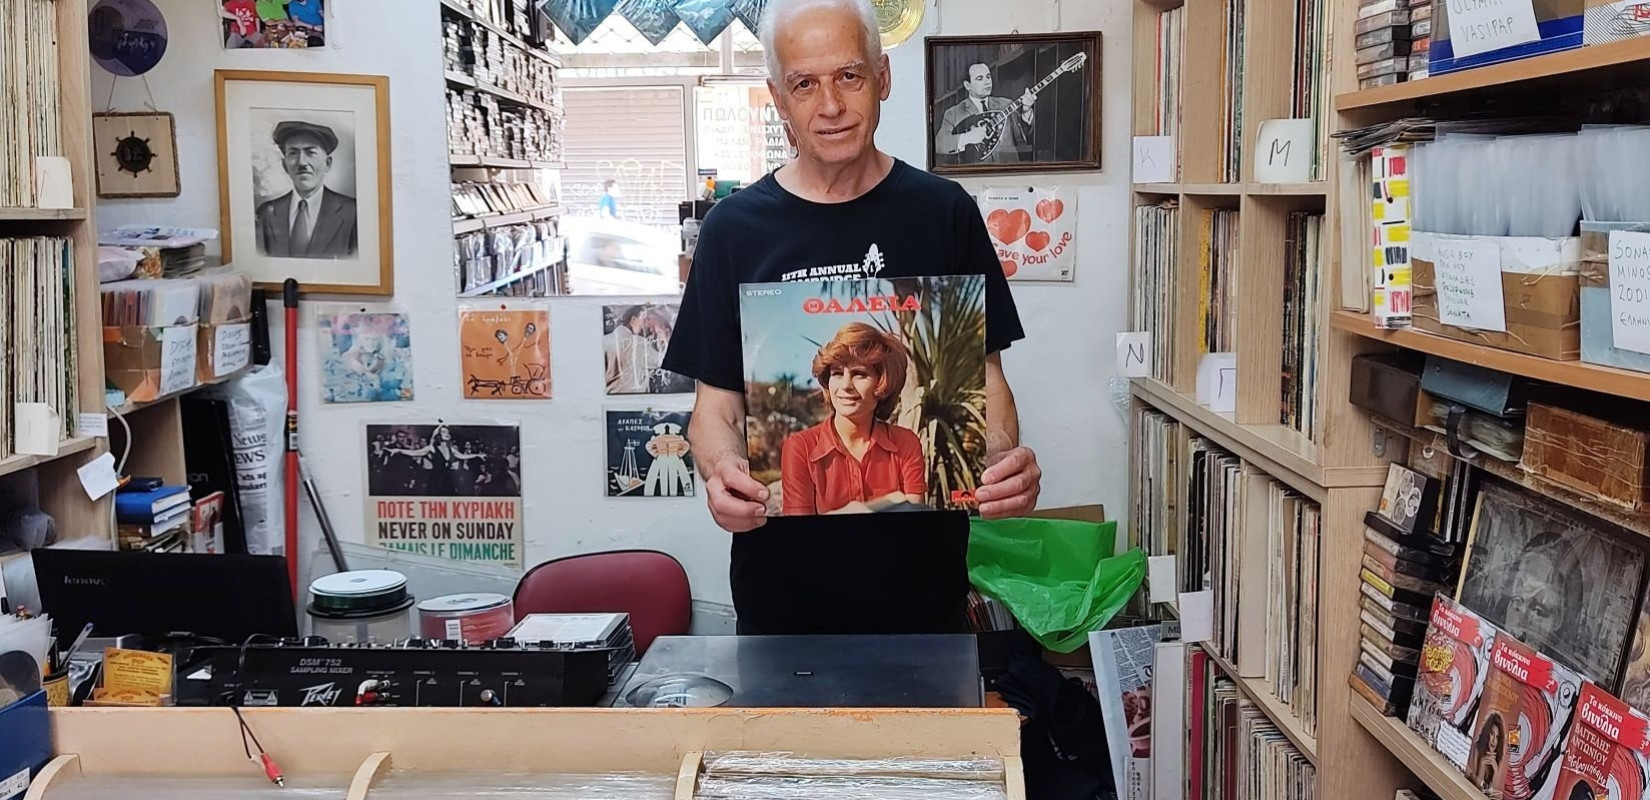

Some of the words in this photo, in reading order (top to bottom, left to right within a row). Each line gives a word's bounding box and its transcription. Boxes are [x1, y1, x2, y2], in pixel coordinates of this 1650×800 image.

[1268, 138, 1292, 167] M
[995, 245, 1019, 260] ave
[1022, 253, 1049, 266] your
[1049, 231, 1072, 259] love
[1614, 240, 1650, 259] SONA
[809, 263, 862, 277] ANNUAL
[745, 288, 782, 297] STEREO
[802, 295, 922, 315] ΘΑΛΕΙΑ
[377, 501, 415, 519] ΠΟΤΕ
[419, 501, 448, 519] ΤΗΝ
[452, 501, 515, 520] ΚΥΡΙΑΚΗ
[378, 521, 428, 540] NEVER
[432, 522, 451, 540] ON
[456, 522, 514, 540] SUNDAY
[449, 543, 516, 561] DIMANCHE
[1501, 642, 1508, 653] Τα
[290, 666, 328, 674] SAMPLING
[329, 666, 353, 674] MIXER
[325, 658, 342, 666] 752
[1494, 649, 1529, 682] βινύλια
[1589, 695, 1597, 707] Τα
[1597, 703, 1623, 724] κόκκινα
[1581, 702, 1620, 740] βινύλια
[1574, 723, 1611, 754] ΒΑΓΓΕΛΗΣ
[1570, 735, 1608, 766] ΑΝΤΩΝΙΟΥ
